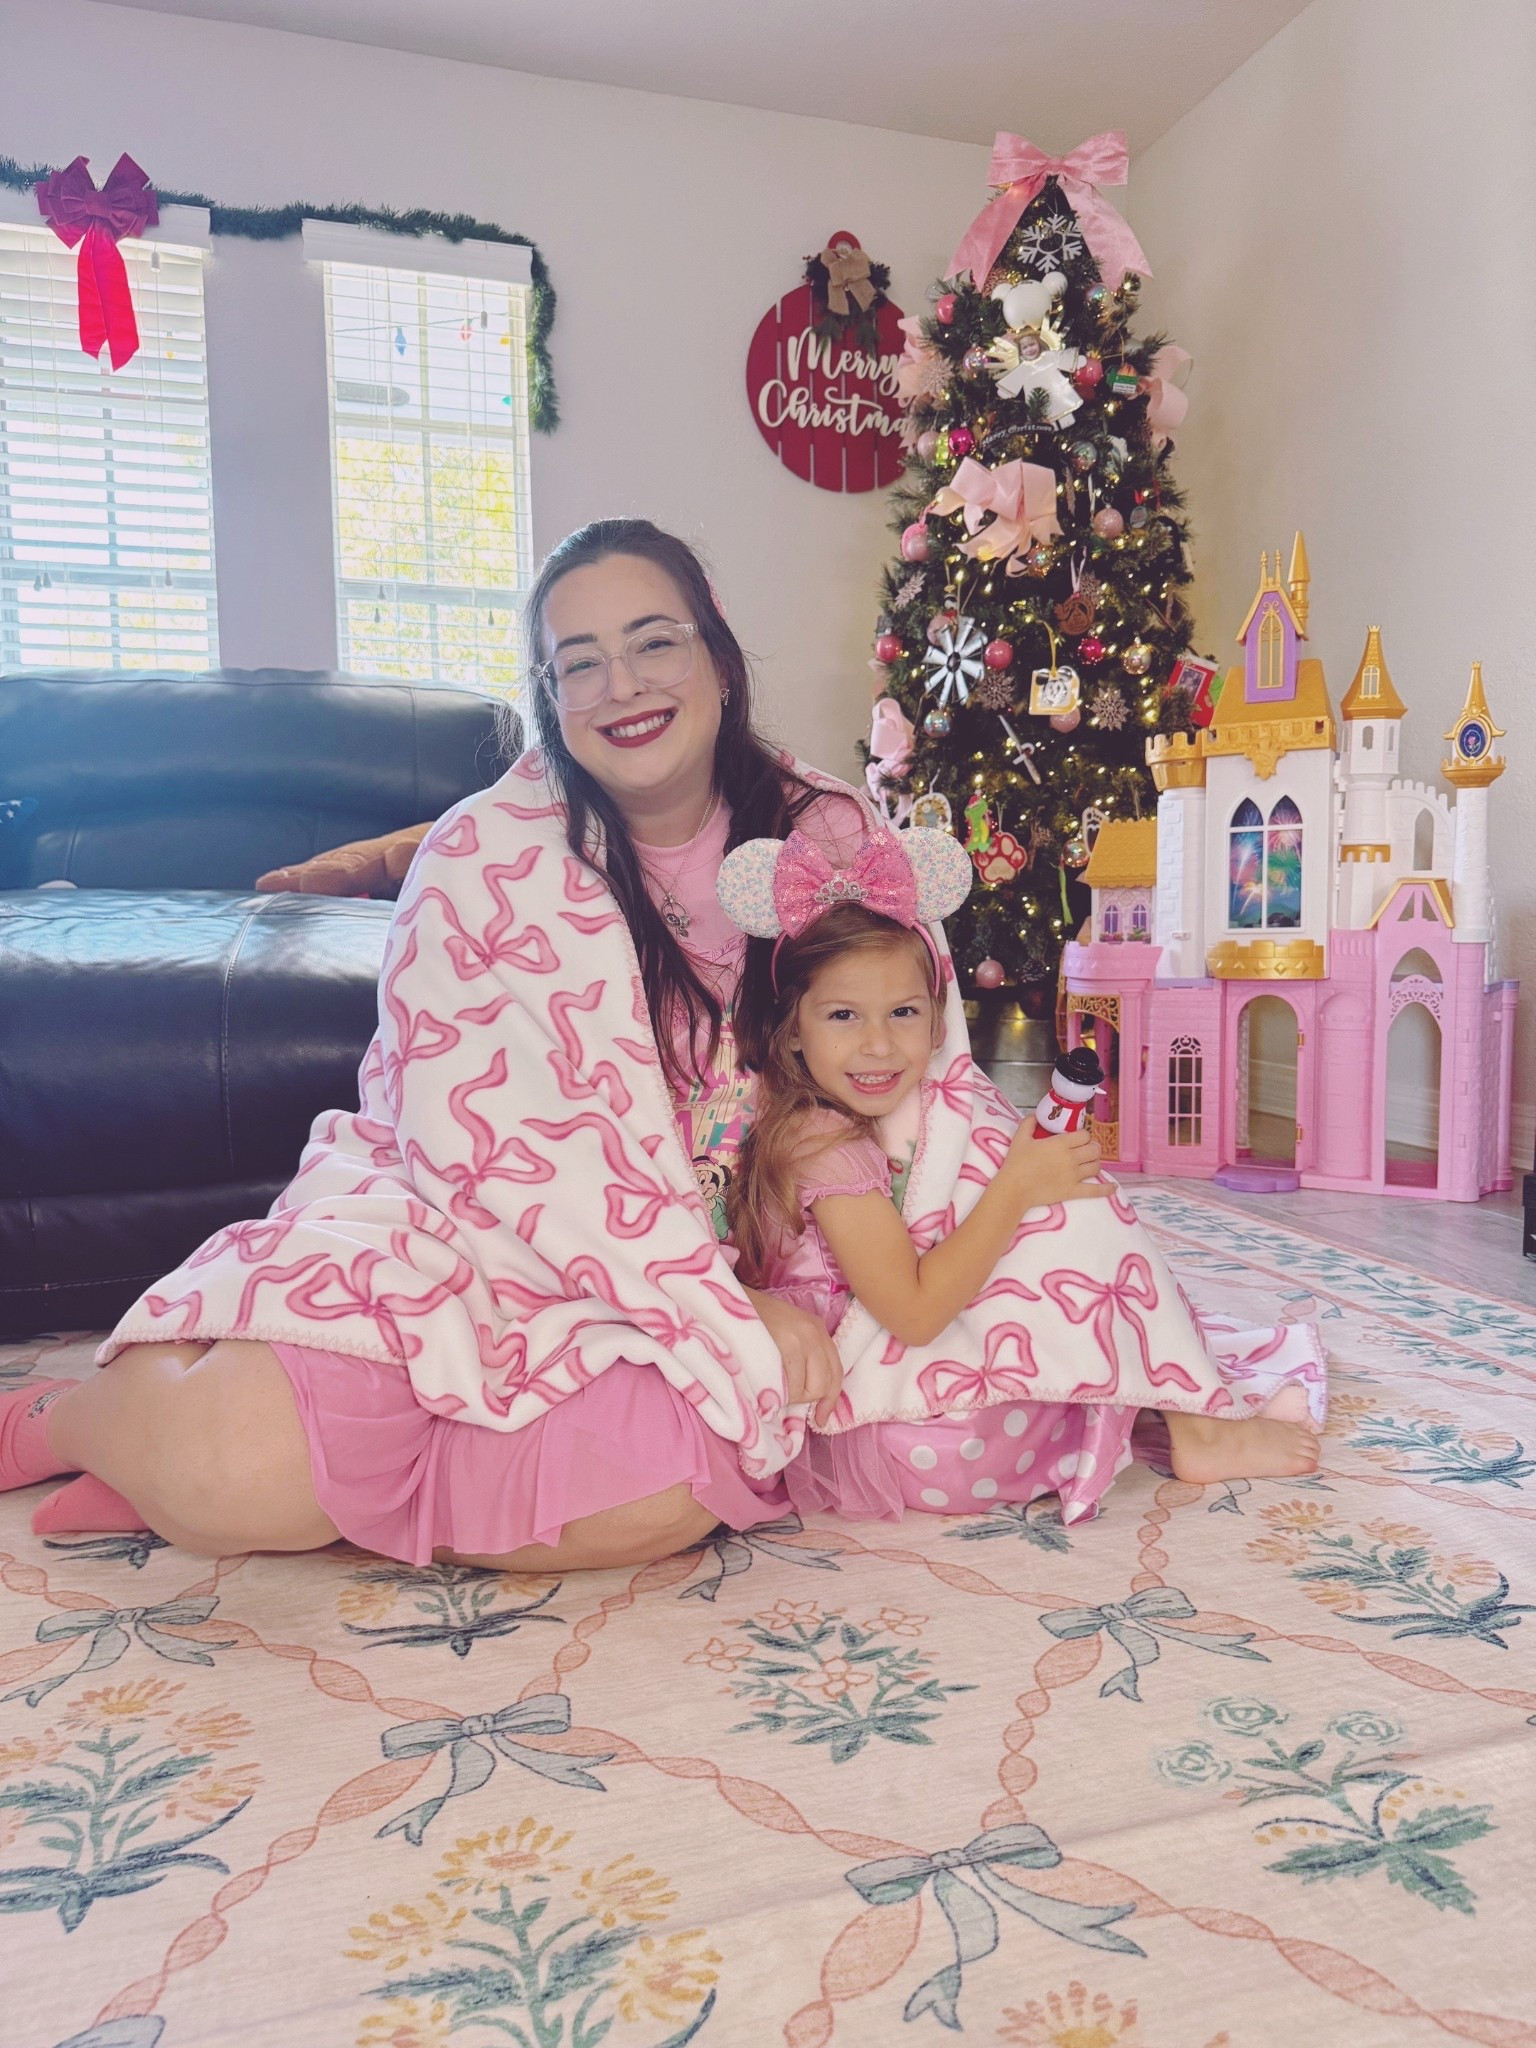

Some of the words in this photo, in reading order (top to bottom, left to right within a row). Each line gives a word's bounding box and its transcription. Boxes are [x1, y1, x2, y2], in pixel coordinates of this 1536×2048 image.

[787, 326, 901, 396] Merry
[758, 379, 908, 437] Christma
[982, 429, 1006, 447] Merry
[1007, 424, 1052, 434] Christmas
